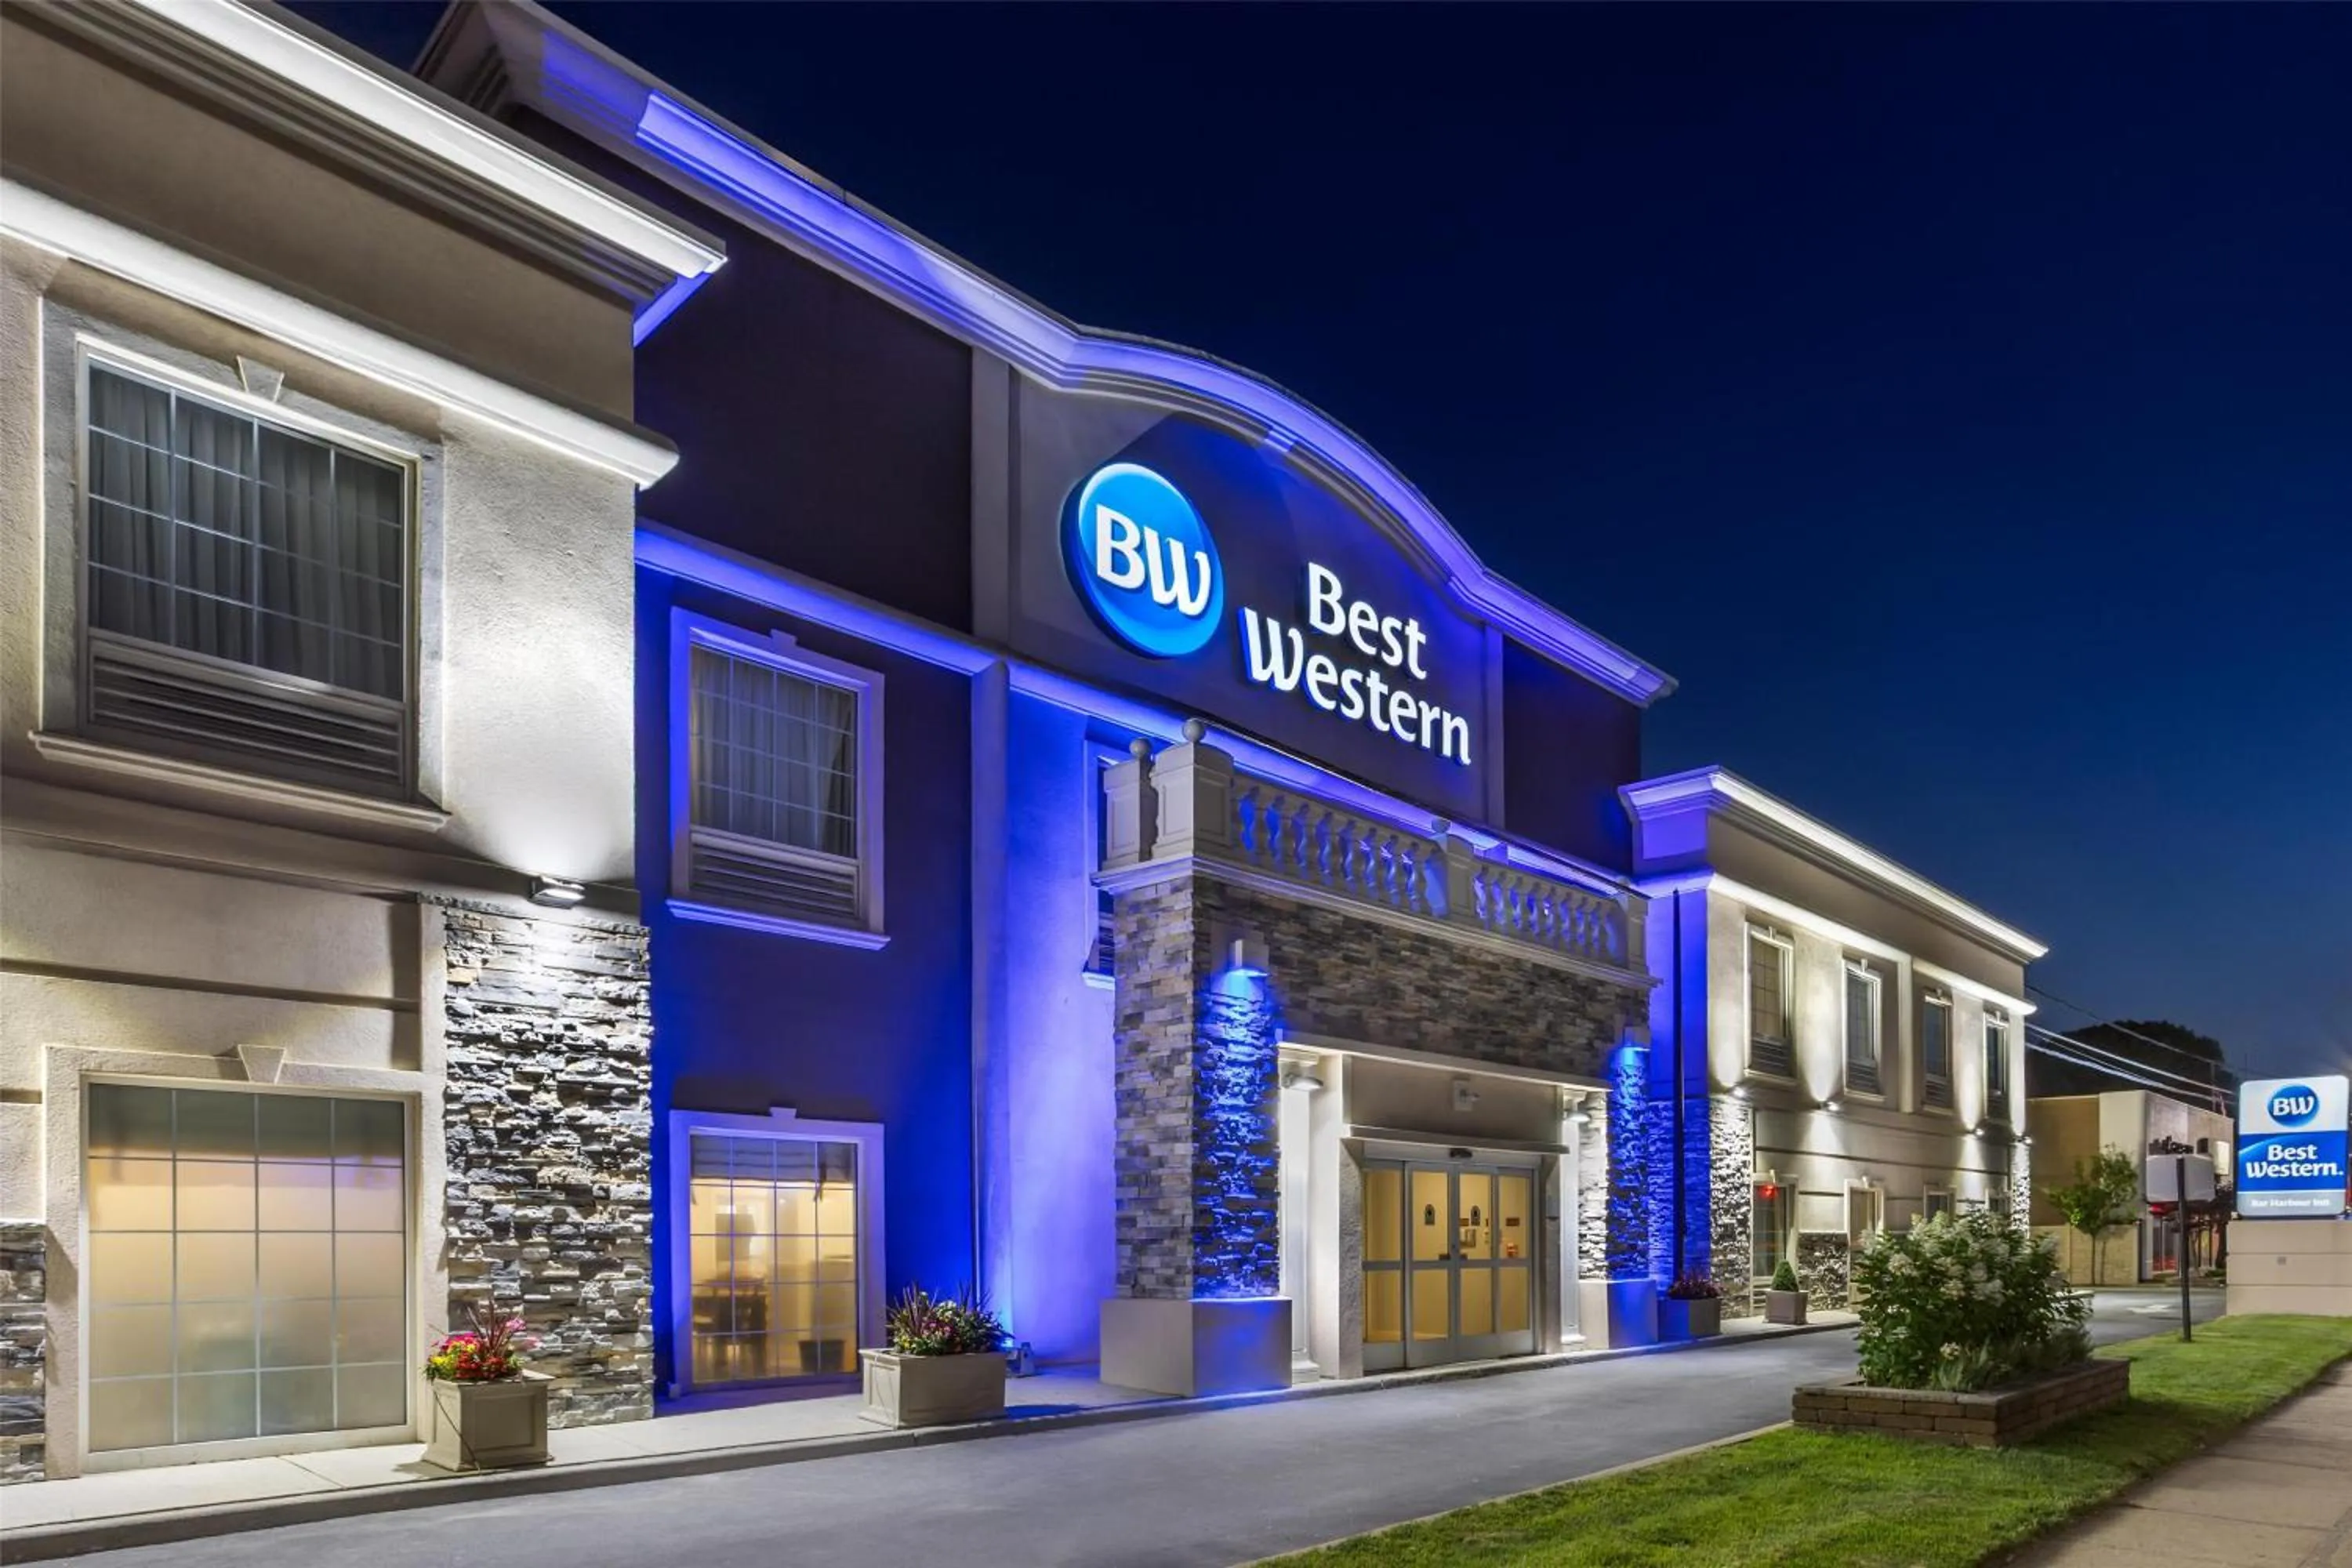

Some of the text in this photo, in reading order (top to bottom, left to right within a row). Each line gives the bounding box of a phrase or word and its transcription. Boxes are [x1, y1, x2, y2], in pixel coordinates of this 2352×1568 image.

[1097, 504, 1210, 615] BW
[1308, 561, 1428, 680] Best
[1242, 607, 1471, 765] Western
[2268, 1144, 2318, 1161] Best
[2274, 1096, 2314, 1116] BW
